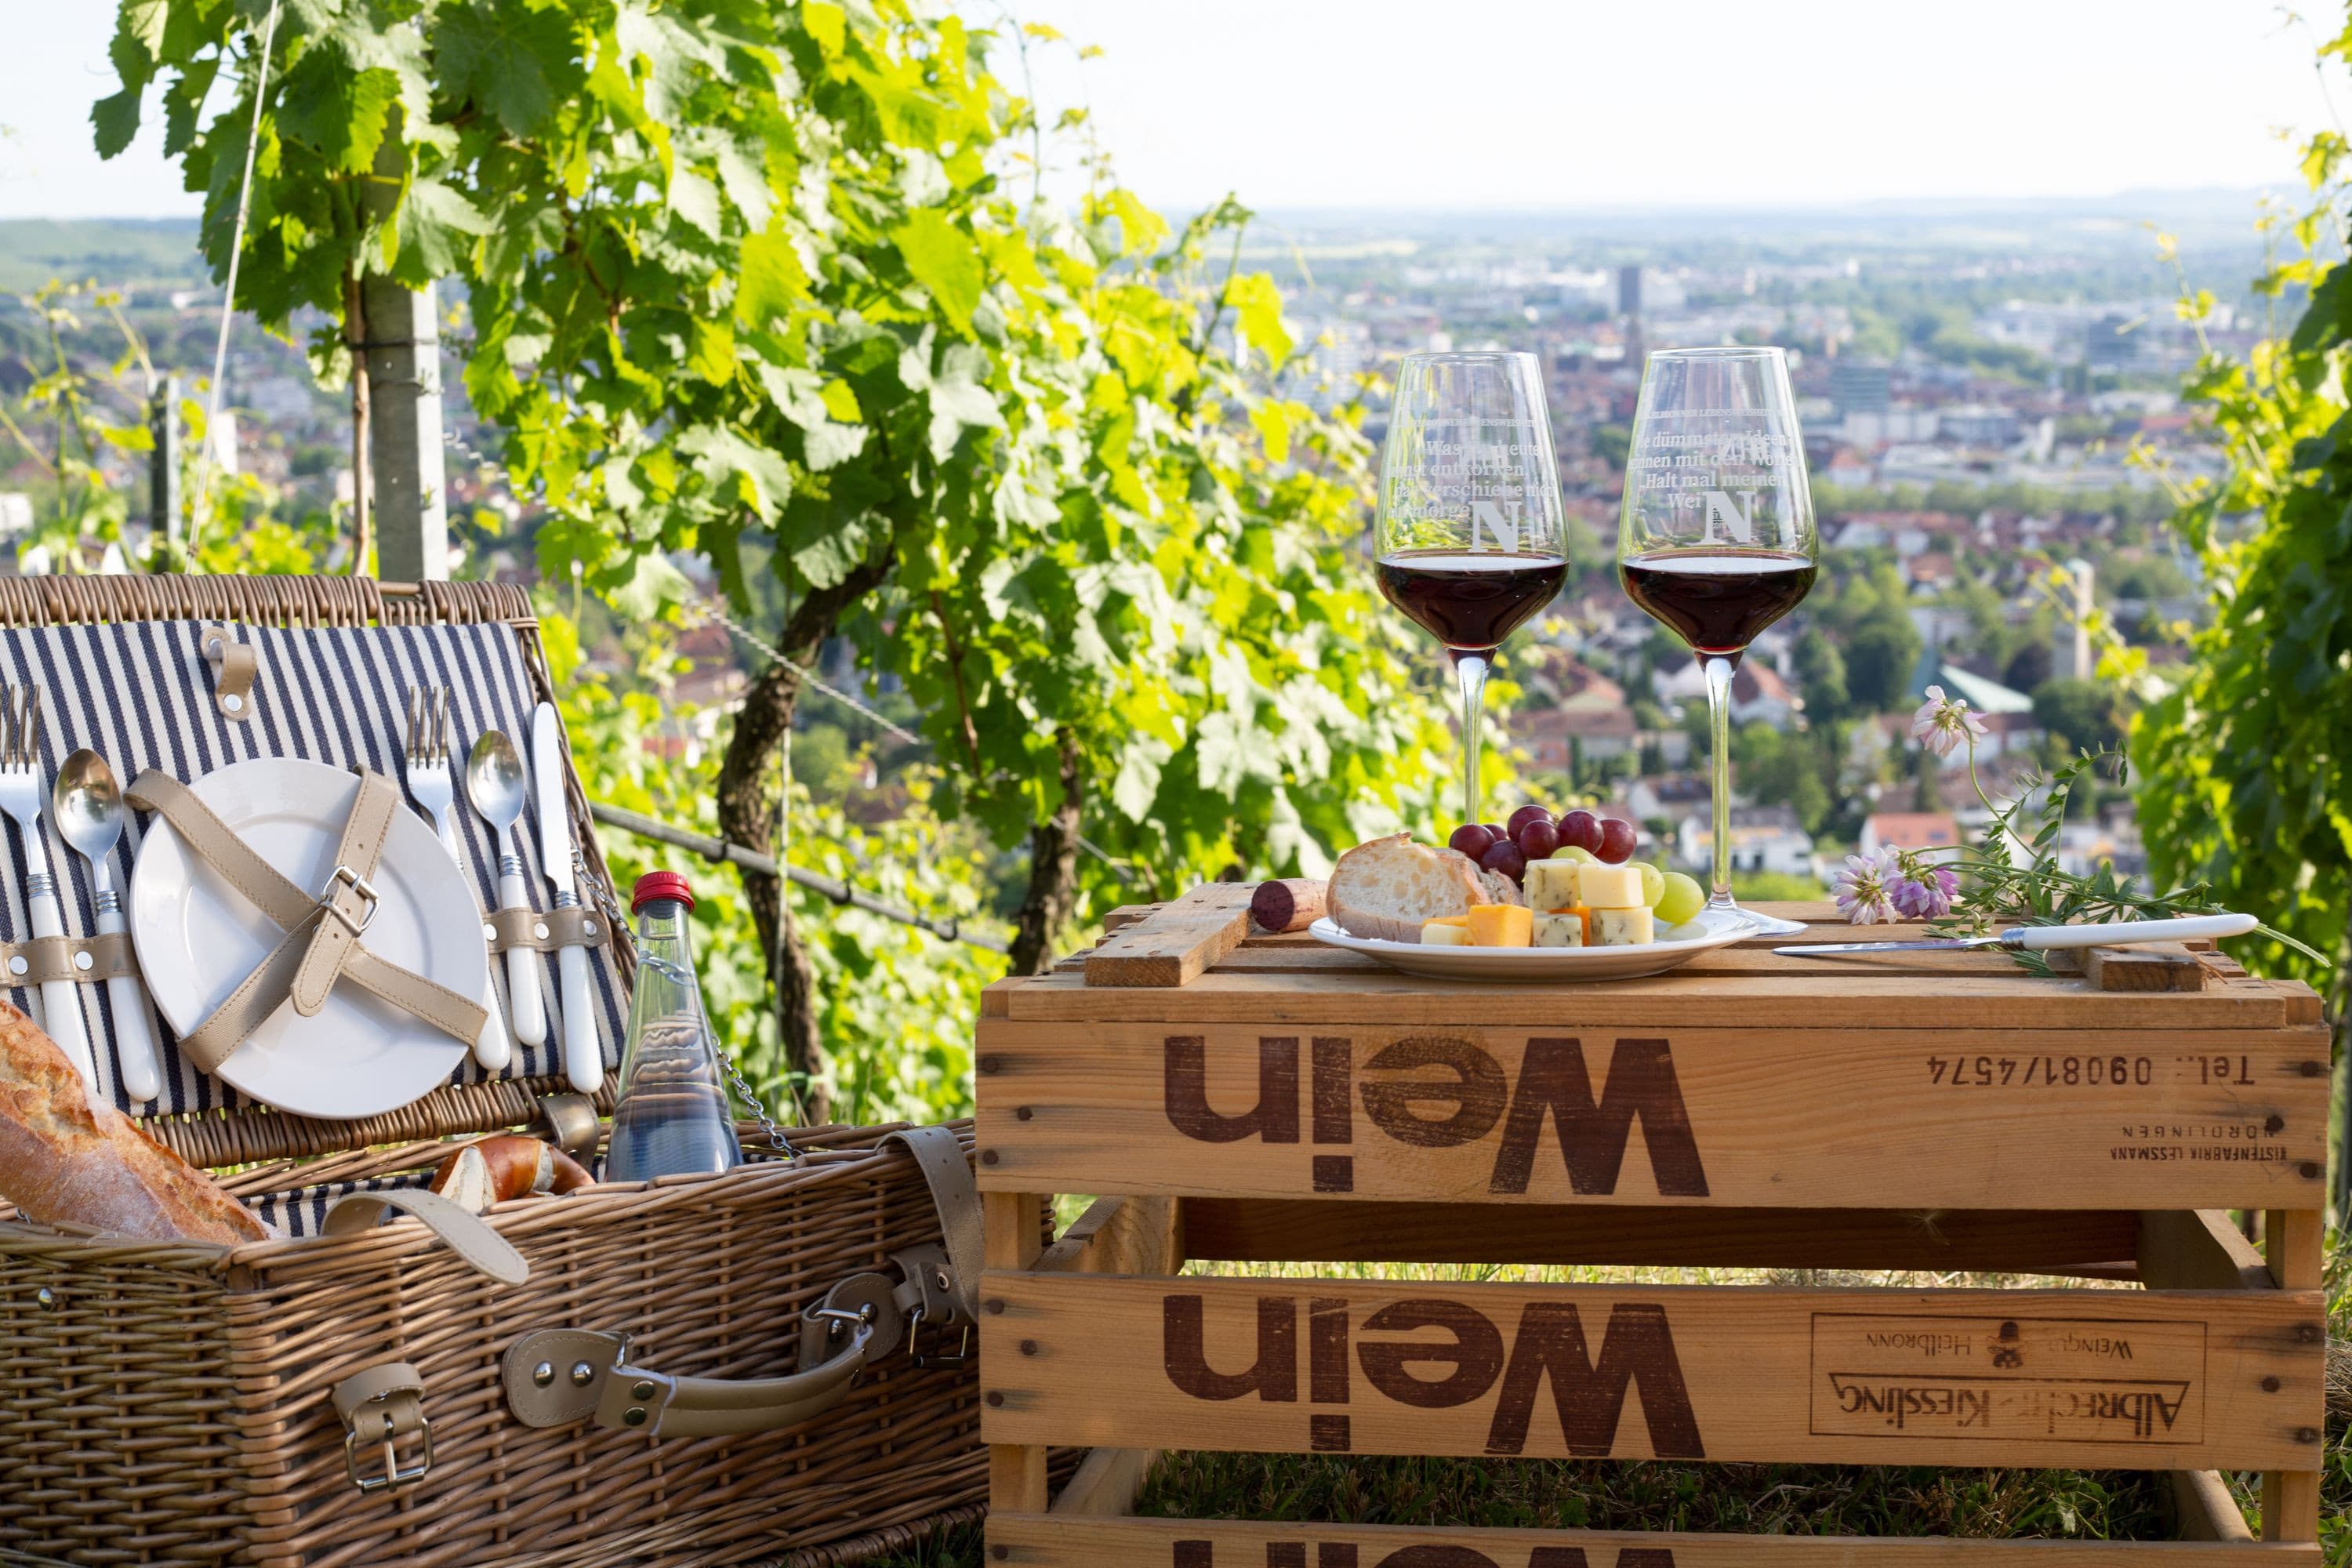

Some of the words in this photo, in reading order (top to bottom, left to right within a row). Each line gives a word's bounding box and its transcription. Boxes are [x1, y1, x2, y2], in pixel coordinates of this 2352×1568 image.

[1429, 459, 1524, 477] entkorken
[1675, 450, 1708, 467] mit
[1681, 470, 1716, 487] mal
[1720, 470, 1786, 487] meinen
[1926, 1055, 2152, 1086] 09081/4574
[1165, 1036, 1710, 1197] Wein
[1163, 1294, 1706, 1458] Wein
